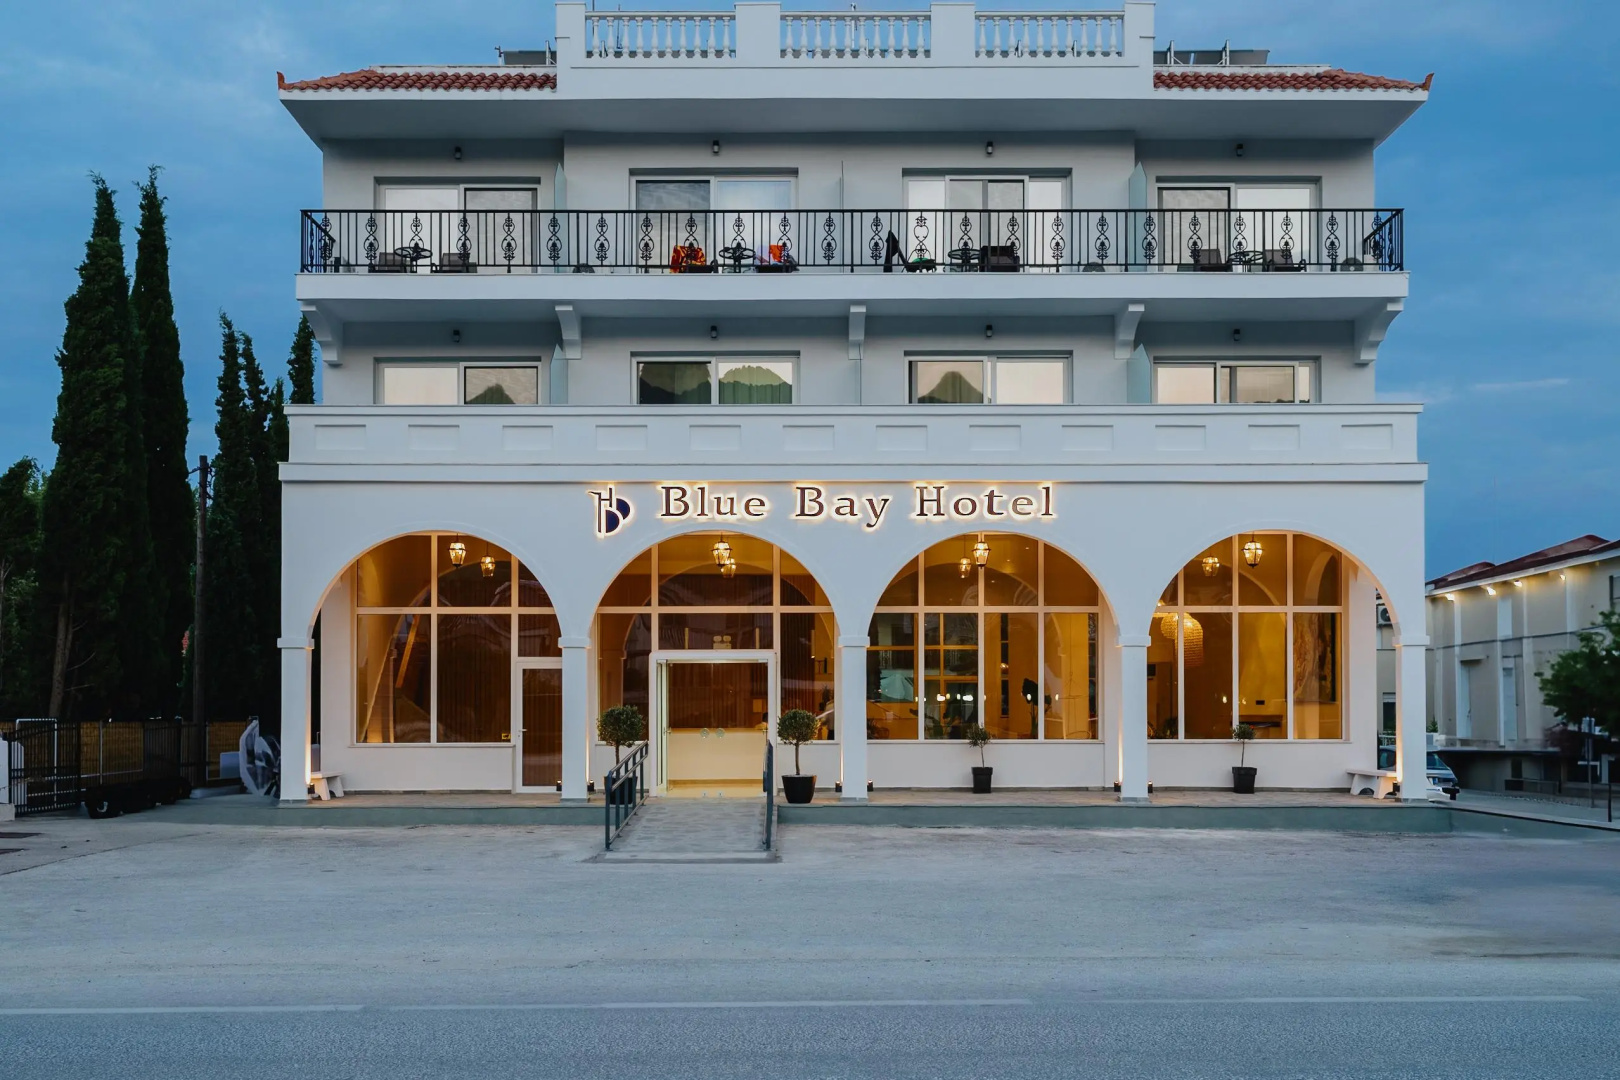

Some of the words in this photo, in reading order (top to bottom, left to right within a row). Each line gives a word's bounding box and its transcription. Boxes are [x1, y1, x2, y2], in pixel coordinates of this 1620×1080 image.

[659, 485, 767, 518] Blue
[794, 485, 891, 529] Bay
[914, 485, 1054, 518] Hotel
